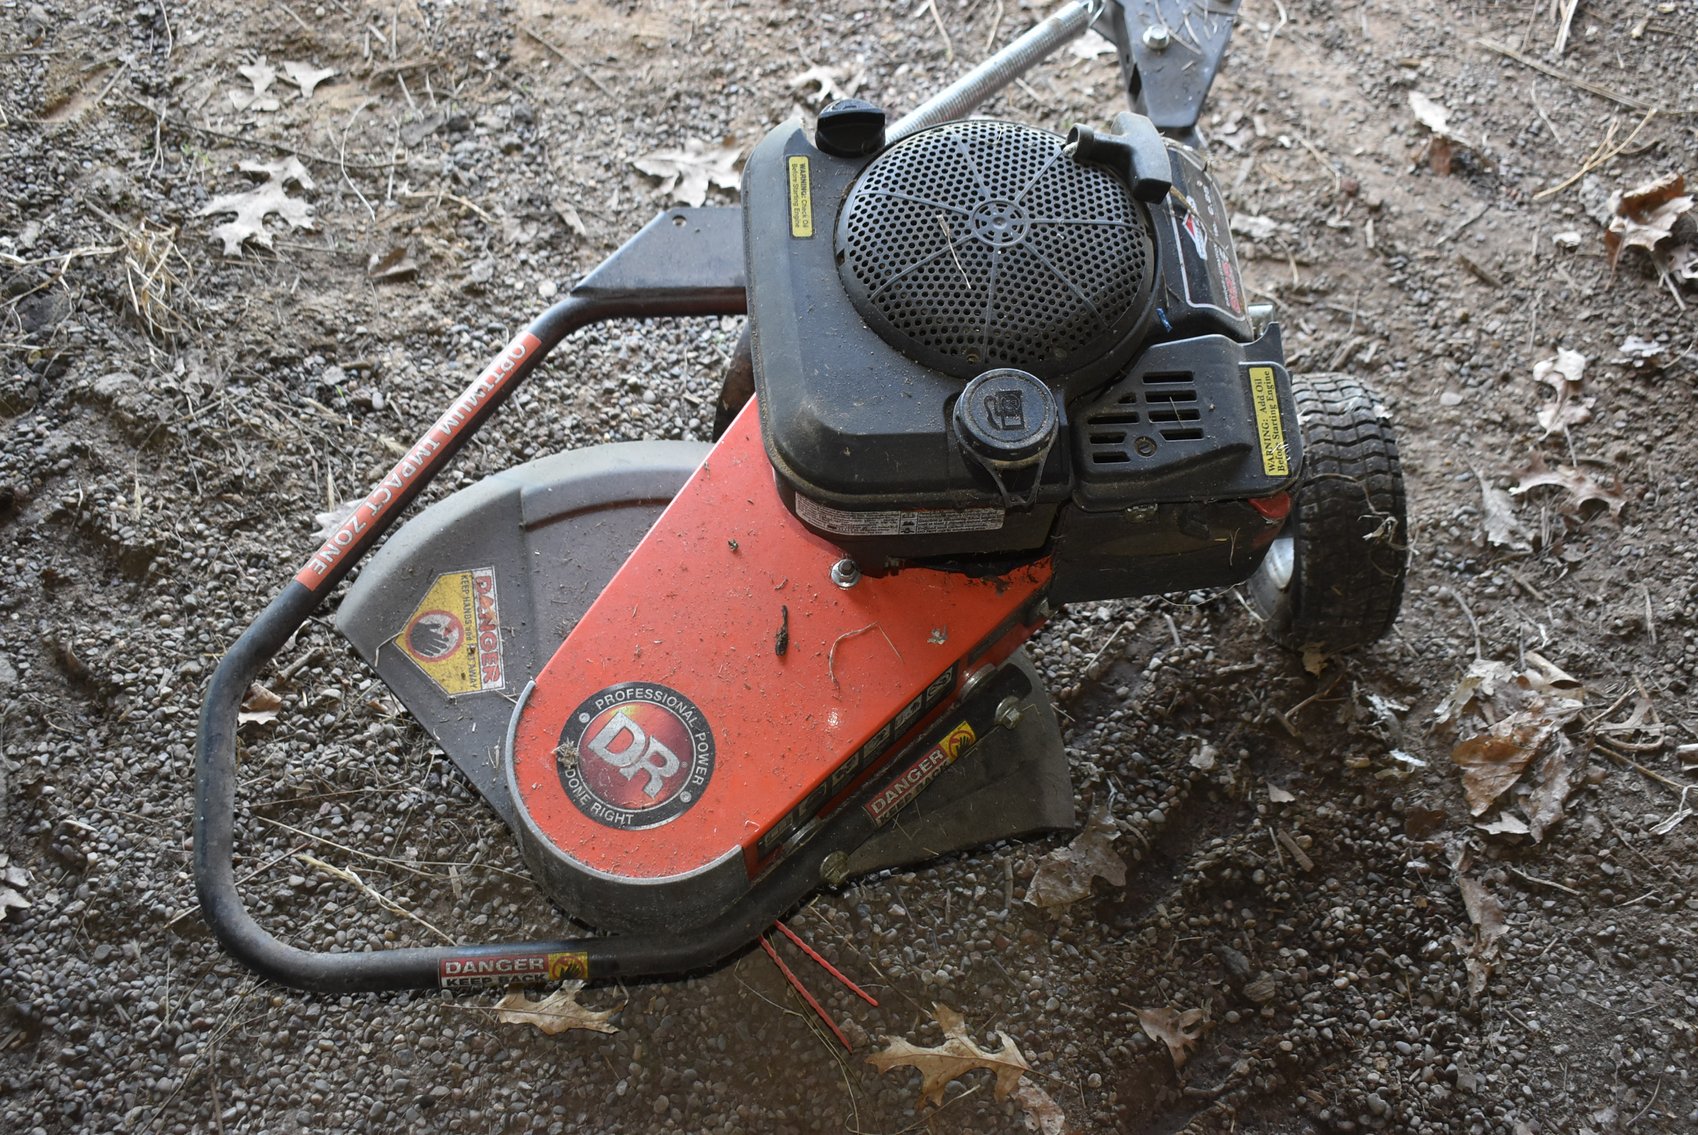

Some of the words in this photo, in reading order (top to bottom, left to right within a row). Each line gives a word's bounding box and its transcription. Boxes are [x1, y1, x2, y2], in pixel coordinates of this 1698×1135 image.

[793, 208, 801, 228] Engine
[442, 343, 527, 436] OPTIMUM
[1254, 378, 1264, 393] Oil
[1264, 370, 1276, 402] Engine
[1256, 394, 1268, 414] Add
[1269, 404, 1280, 440] Starting
[1262, 419, 1276, 472] WARNING:
[366, 438, 443, 517] IMPACT
[307, 520, 367, 576] ZONE
[460, 575, 469, 594] KEEP
[462, 596, 472, 625] HANDS
[465, 626, 474, 641] and
[475, 575, 501, 684] DANGER
[468, 664, 478, 690] AWAY
[594, 688, 698, 728] PROFESSIONAL
[692, 732, 710, 786] POWER
[587, 710, 680, 800] DR
[564, 767, 591, 806] DONE
[590, 802, 634, 825] RIGHT
[871, 749, 944, 814] DANGER
[444, 958, 545, 974] DANGER
[446, 977, 493, 988] KEEP
